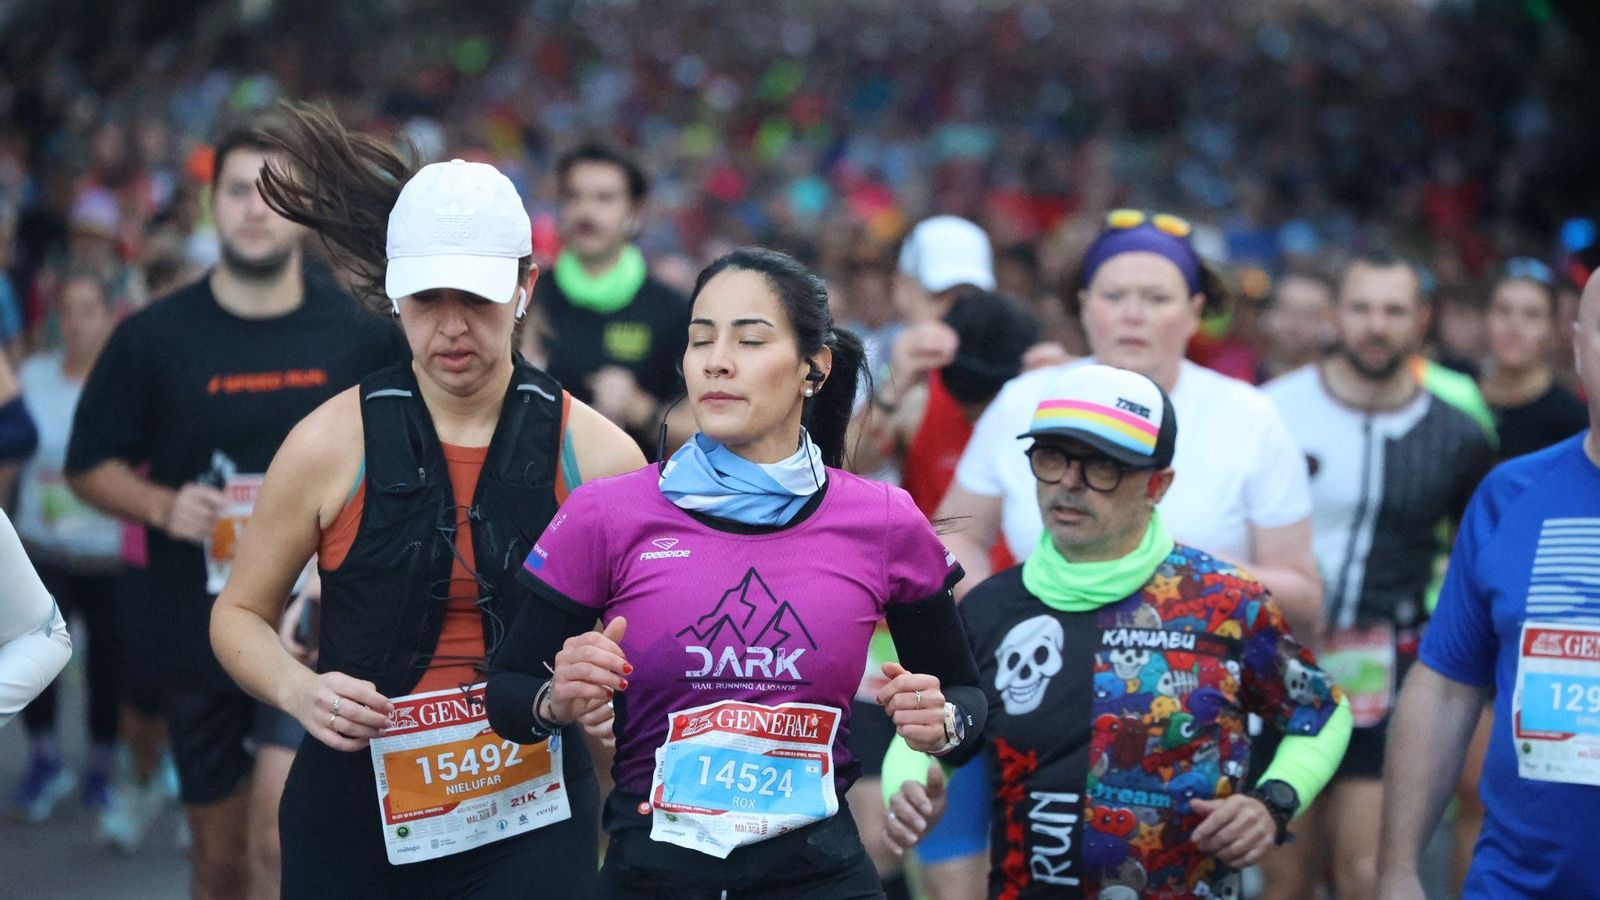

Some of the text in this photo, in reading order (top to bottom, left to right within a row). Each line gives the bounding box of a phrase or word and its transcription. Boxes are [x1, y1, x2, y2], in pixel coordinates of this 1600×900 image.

[431, 223, 480, 240] adidas
[1102, 628, 1195, 650] KAMUABU
[685, 645, 806, 680] DARK
[716, 708, 819, 739] GENERALI
[416, 740, 523, 785] 15492
[445, 774, 502, 796] NIELUFAR
[698, 755, 793, 798] 14524
[511, 791, 537, 808] 21K
[536, 803, 559, 817] renfe
[732, 796, 756, 809] ROX
[1027, 791, 1080, 886] RUN
